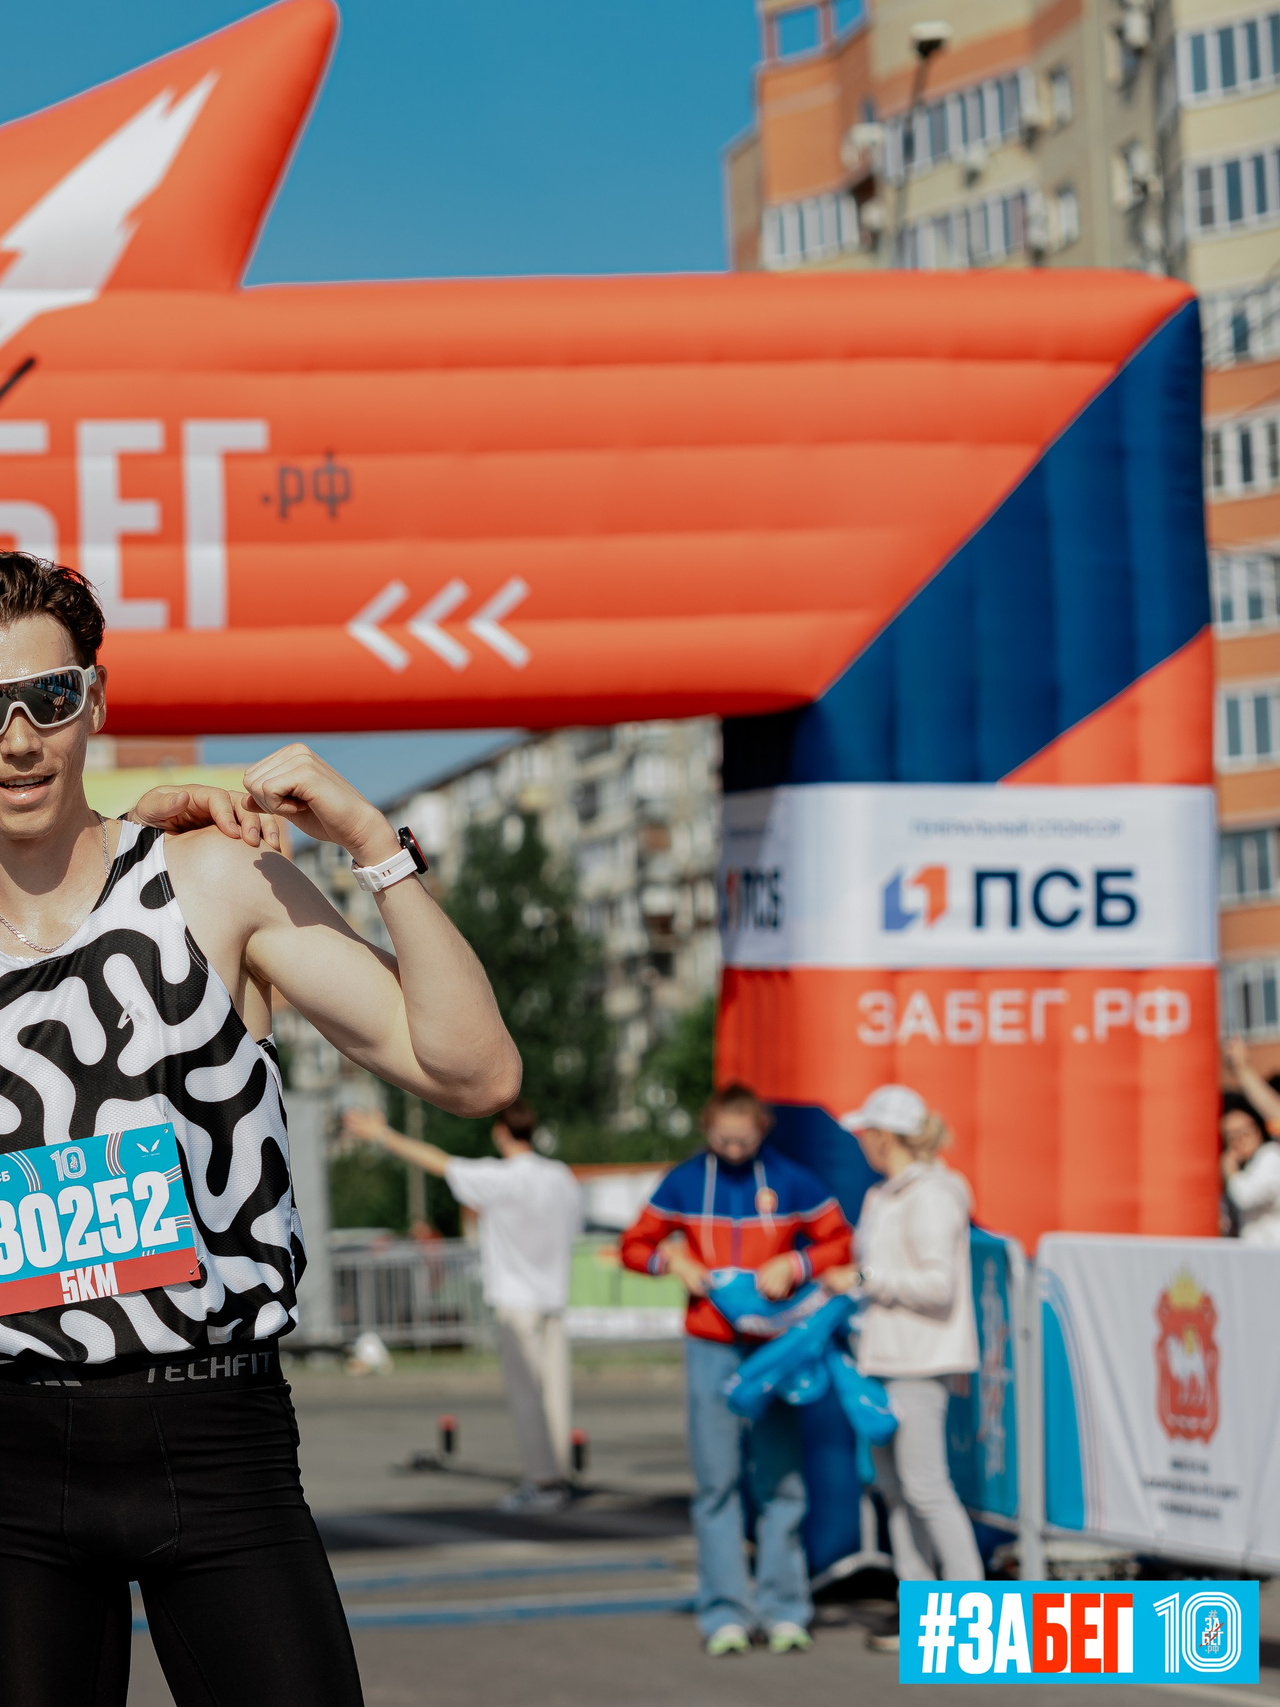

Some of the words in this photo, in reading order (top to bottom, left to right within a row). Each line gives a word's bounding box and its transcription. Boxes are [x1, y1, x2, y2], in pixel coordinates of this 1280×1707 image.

[975, 869, 1138, 928] ПСБ
[856, 988, 1192, 1045] ЗАБЕГ.РФ
[147, 1352, 273, 1384] TECHFIT
